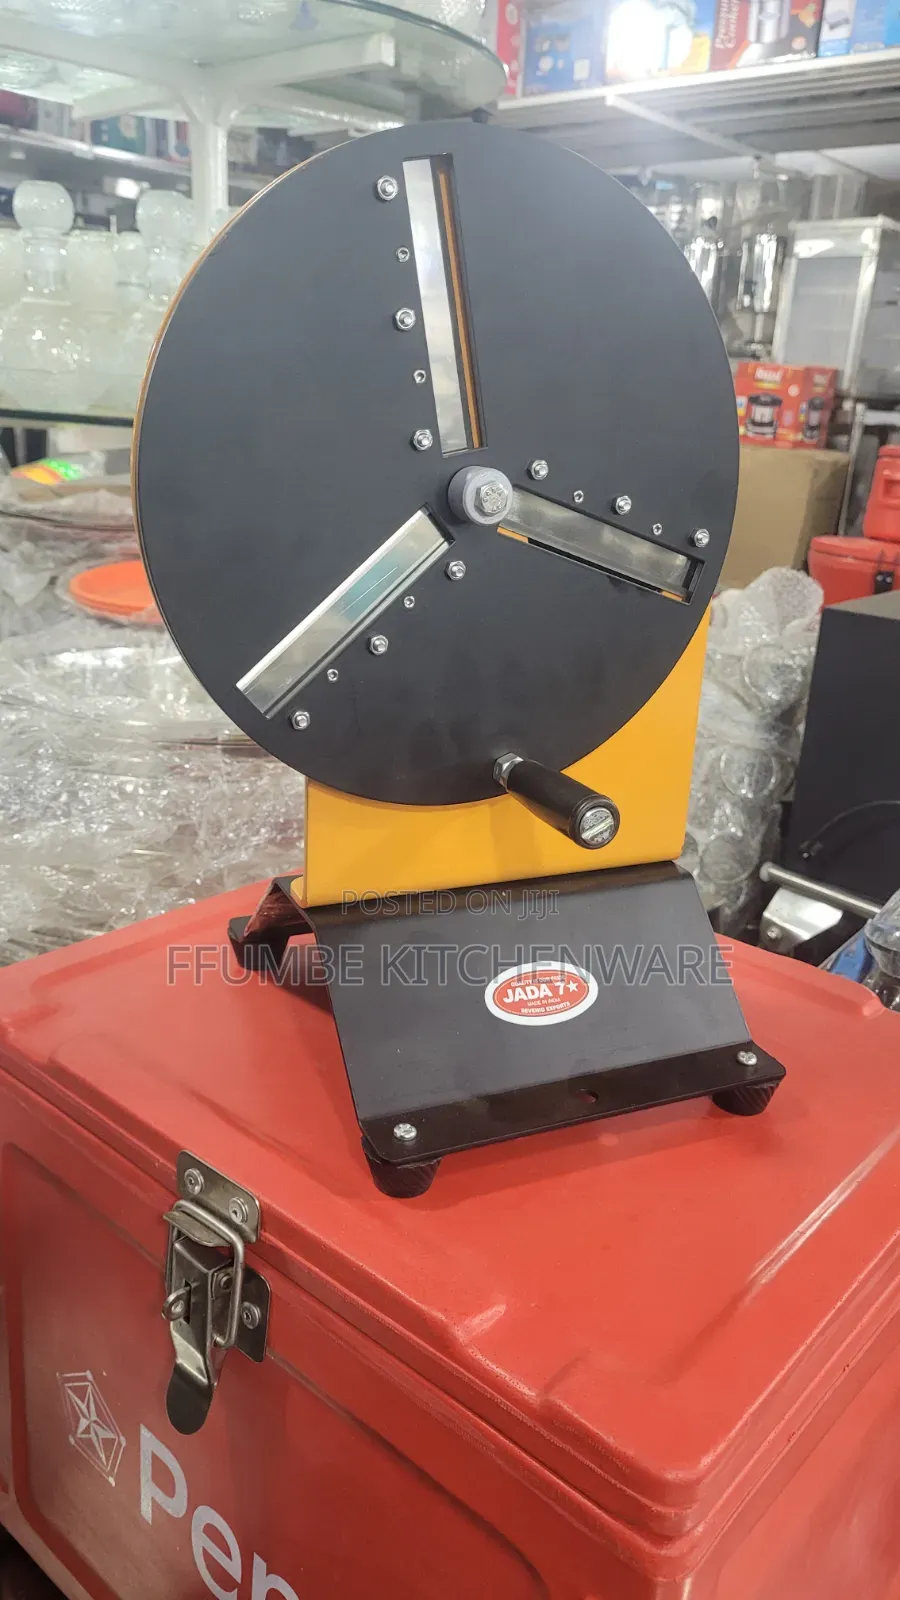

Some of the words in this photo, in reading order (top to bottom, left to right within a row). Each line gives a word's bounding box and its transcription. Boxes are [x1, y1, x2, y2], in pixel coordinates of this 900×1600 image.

[510, 979, 532, 987] QUALITY
[503, 984, 553, 1003] JADA
[554, 982, 566, 995] 7
[546, 1001, 571, 1012] EXPORTS
